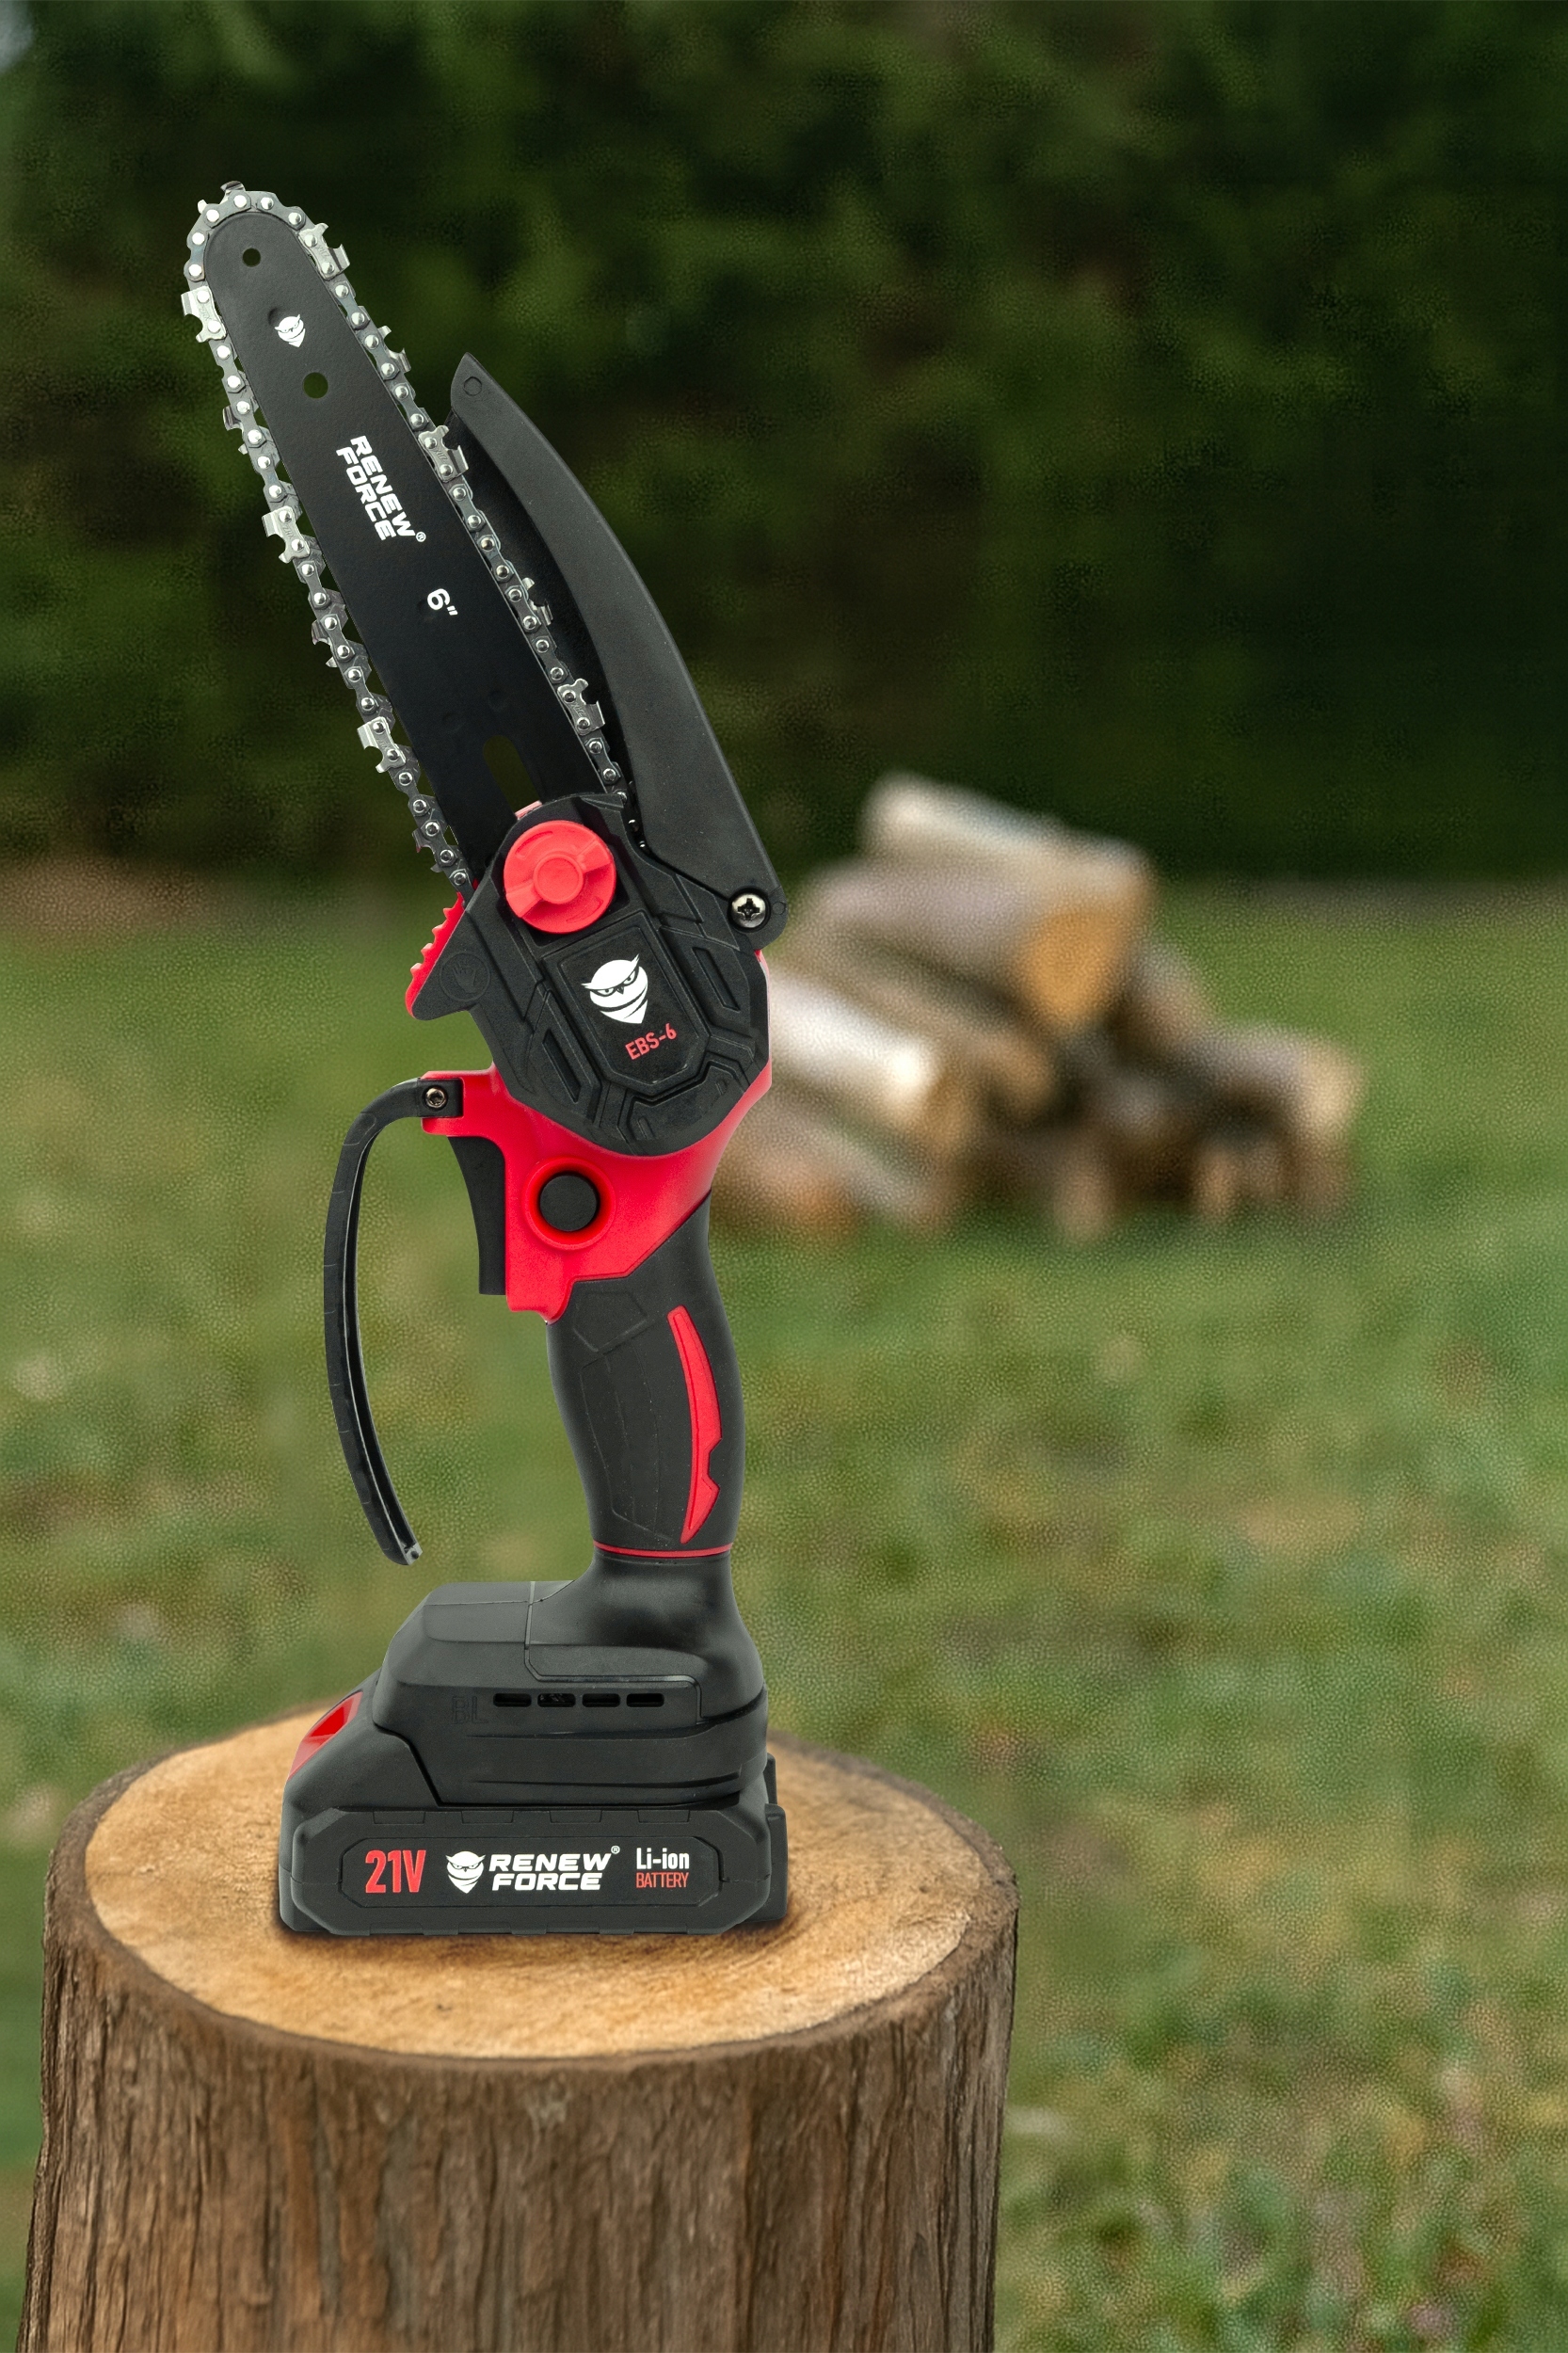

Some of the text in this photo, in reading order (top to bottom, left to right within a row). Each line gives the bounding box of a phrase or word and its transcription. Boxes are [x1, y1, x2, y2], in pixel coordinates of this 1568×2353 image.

[336, 447, 395, 540] FORCE
[625, 1022, 677, 1060] EBS-6
[452, 1695, 489, 1724] BL
[365, 1849, 426, 1894] 21V
[636, 1848, 690, 1870] Li-ion
[492, 1872, 603, 1891] FORCE
[636, 1871, 690, 1888] BATTERY
